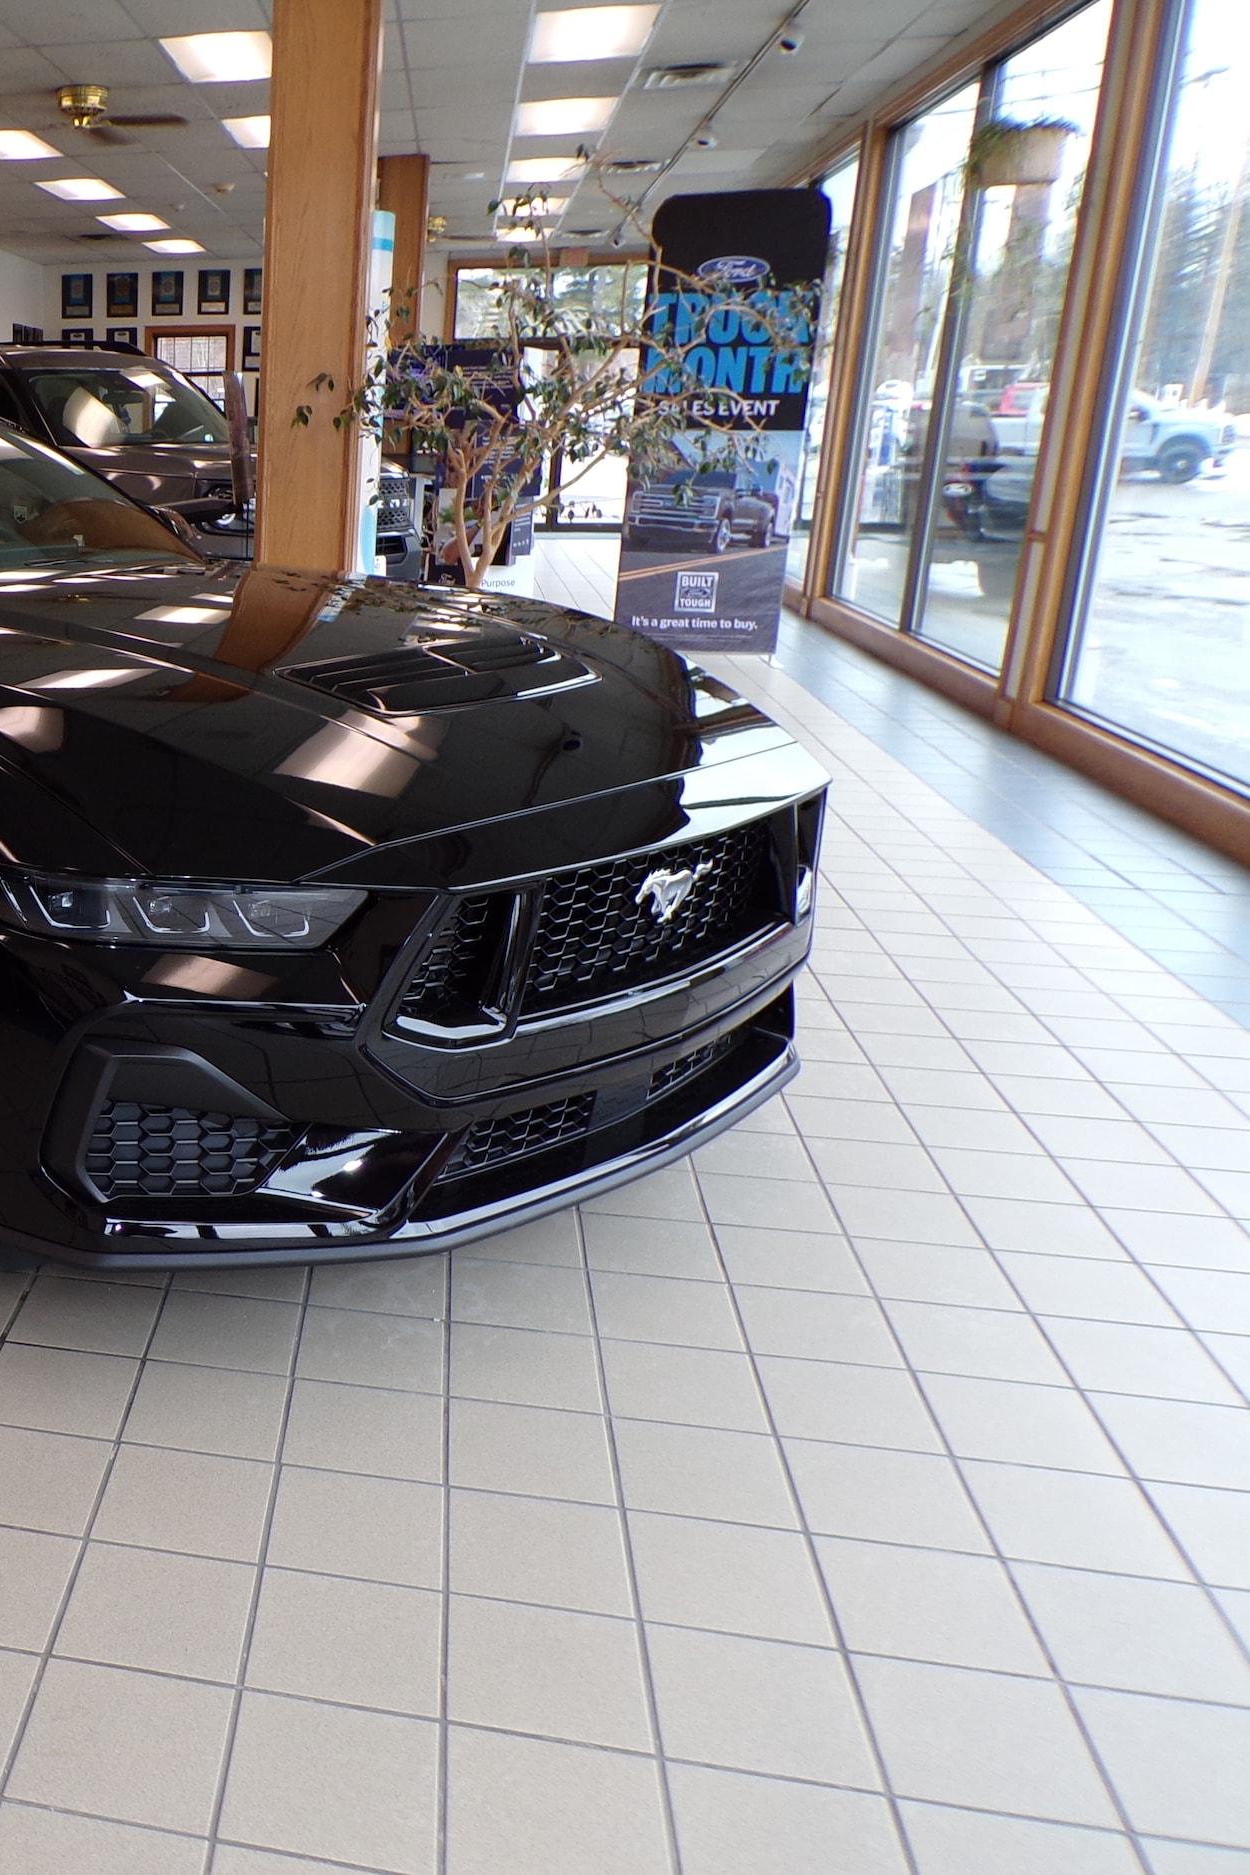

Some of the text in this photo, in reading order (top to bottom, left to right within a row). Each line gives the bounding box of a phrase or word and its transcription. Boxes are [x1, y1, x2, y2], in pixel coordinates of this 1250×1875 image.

[648, 289, 817, 344] TRUCK
[642, 346, 811, 394] MONTH
[718, 400, 780, 417] EVENT
[480, 579, 516, 588] Purpose
[681, 575, 714, 588] BUILT
[679, 597, 712, 609] TOUGH
[631, 615, 759, 631] It's a great time to buy.
